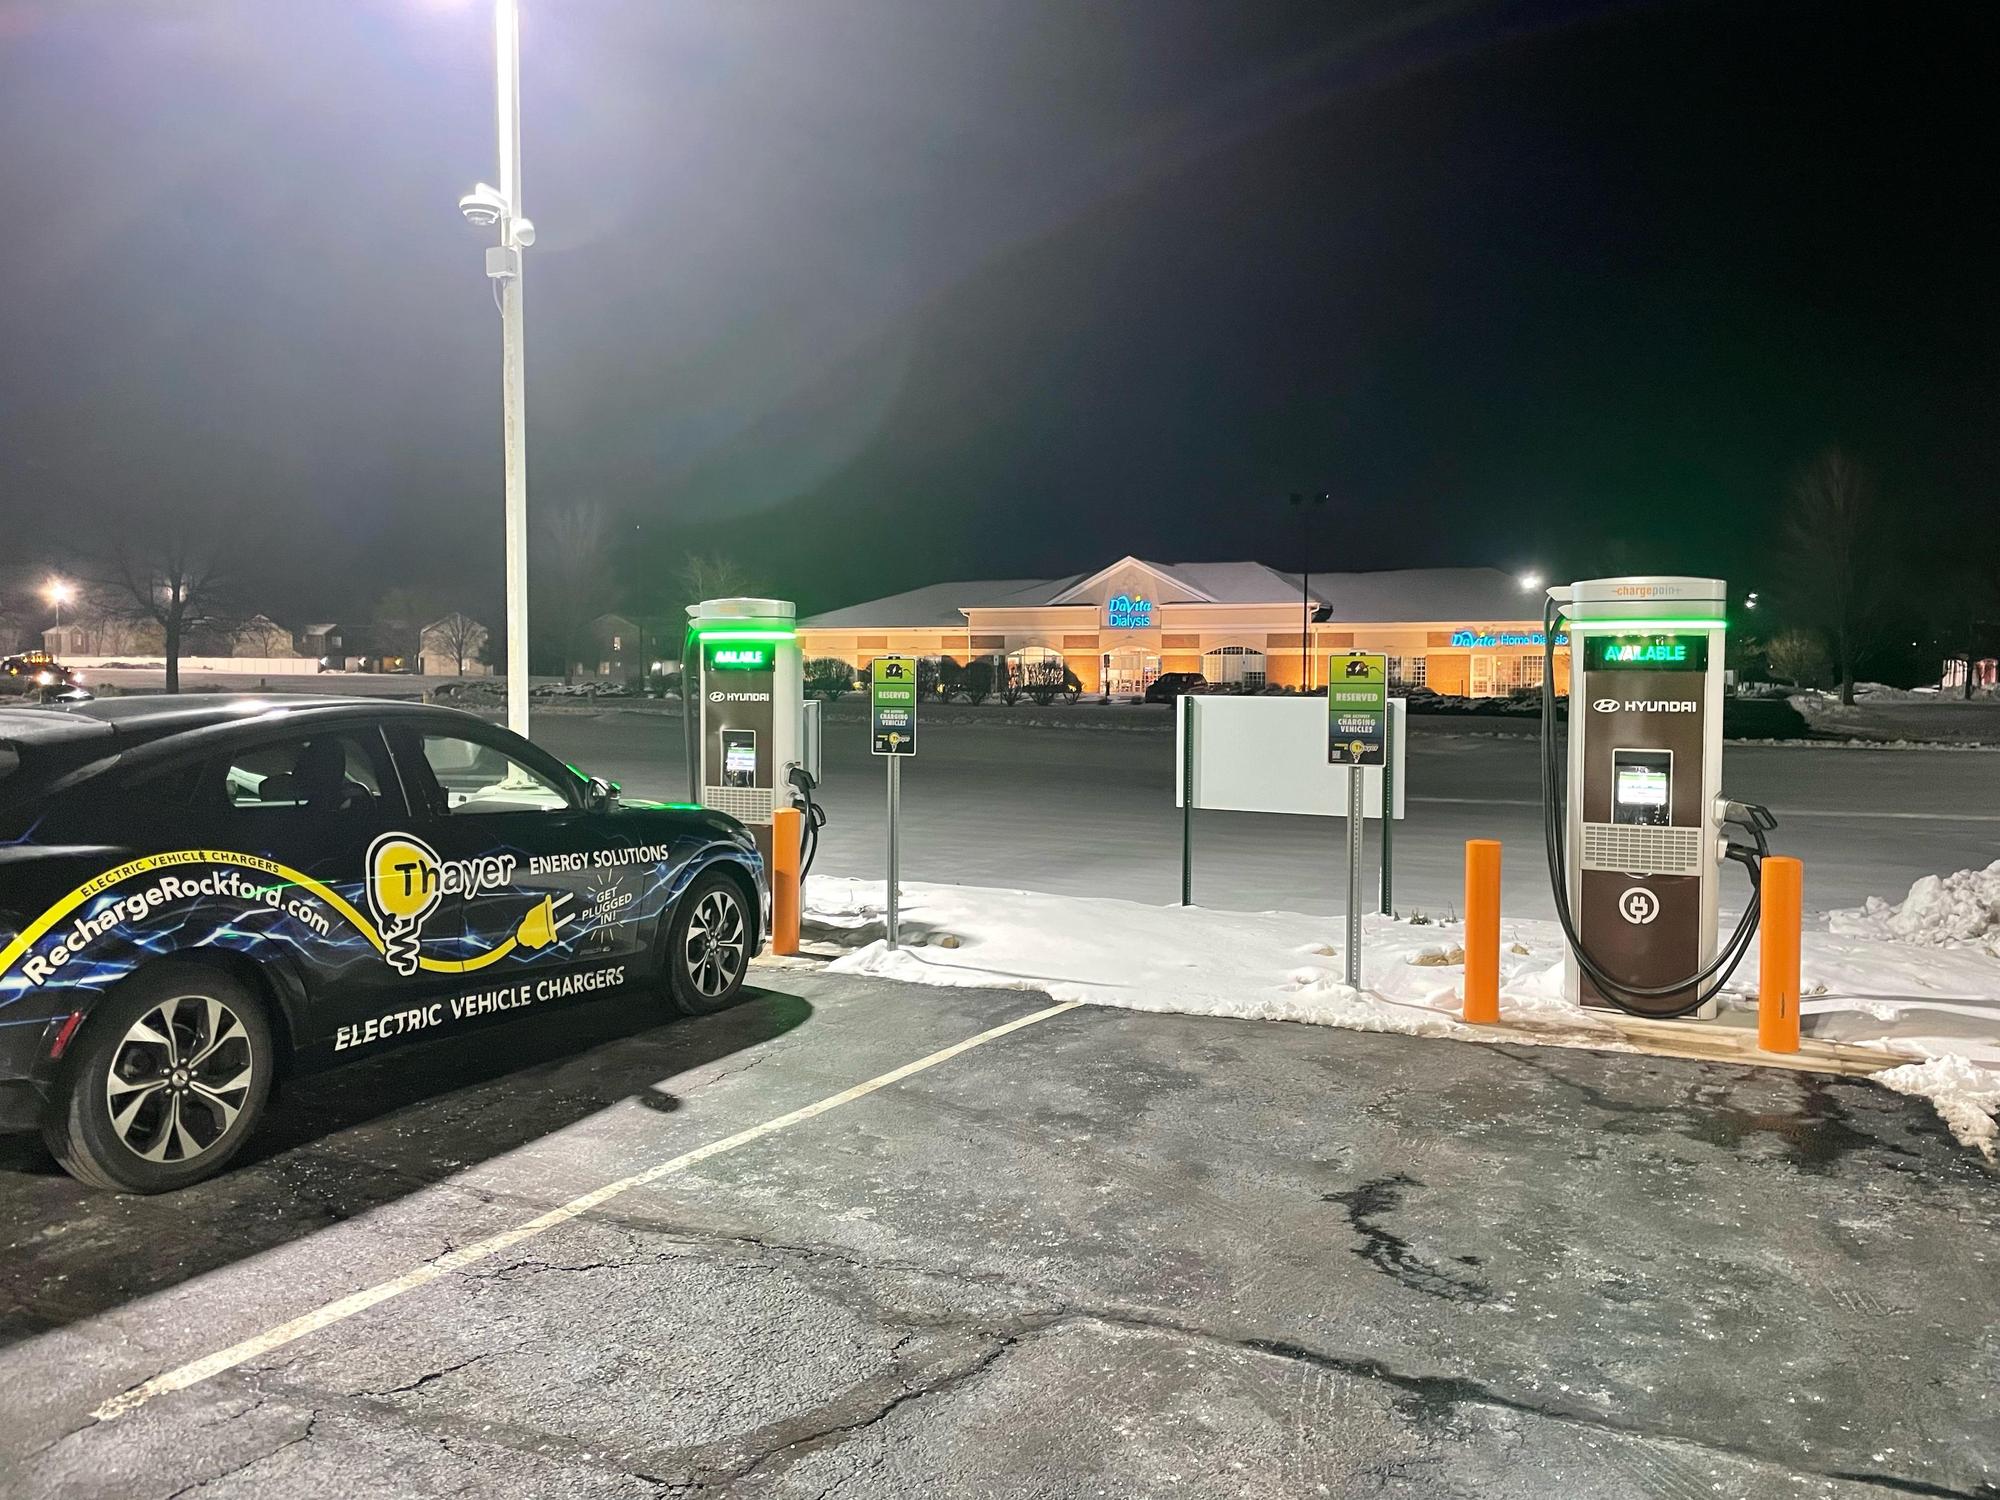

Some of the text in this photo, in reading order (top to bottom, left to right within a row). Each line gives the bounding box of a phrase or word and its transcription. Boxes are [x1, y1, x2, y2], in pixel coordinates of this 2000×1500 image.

[1110, 594, 1151, 613] DaVita
[1110, 614, 1150, 628] Dialysis
[1452, 631, 1568, 648] DaVita Home Diasis
[1605, 645, 1686, 661] AVAILABLE
[727, 693, 769, 701] HYUNDAI
[878, 691, 910, 700] RESERVED
[1336, 693, 1378, 702] RESERVED
[1625, 701, 1696, 712] HYUNDAI
[530, 844, 669, 875] ENERGY SOLUTIONS
[80, 851, 280, 896] ELECTRIC VEHICLE CHARGERS
[394, 852, 516, 900] Thayer
[596, 886, 618, 903] GET
[581, 893, 632, 920] PLUGGED
[600, 910, 616, 925] IN!
[22, 872, 330, 986] RechargeRockford.com
[335, 966, 625, 1051] ELECTRIC VEHICLE CHARGERS
